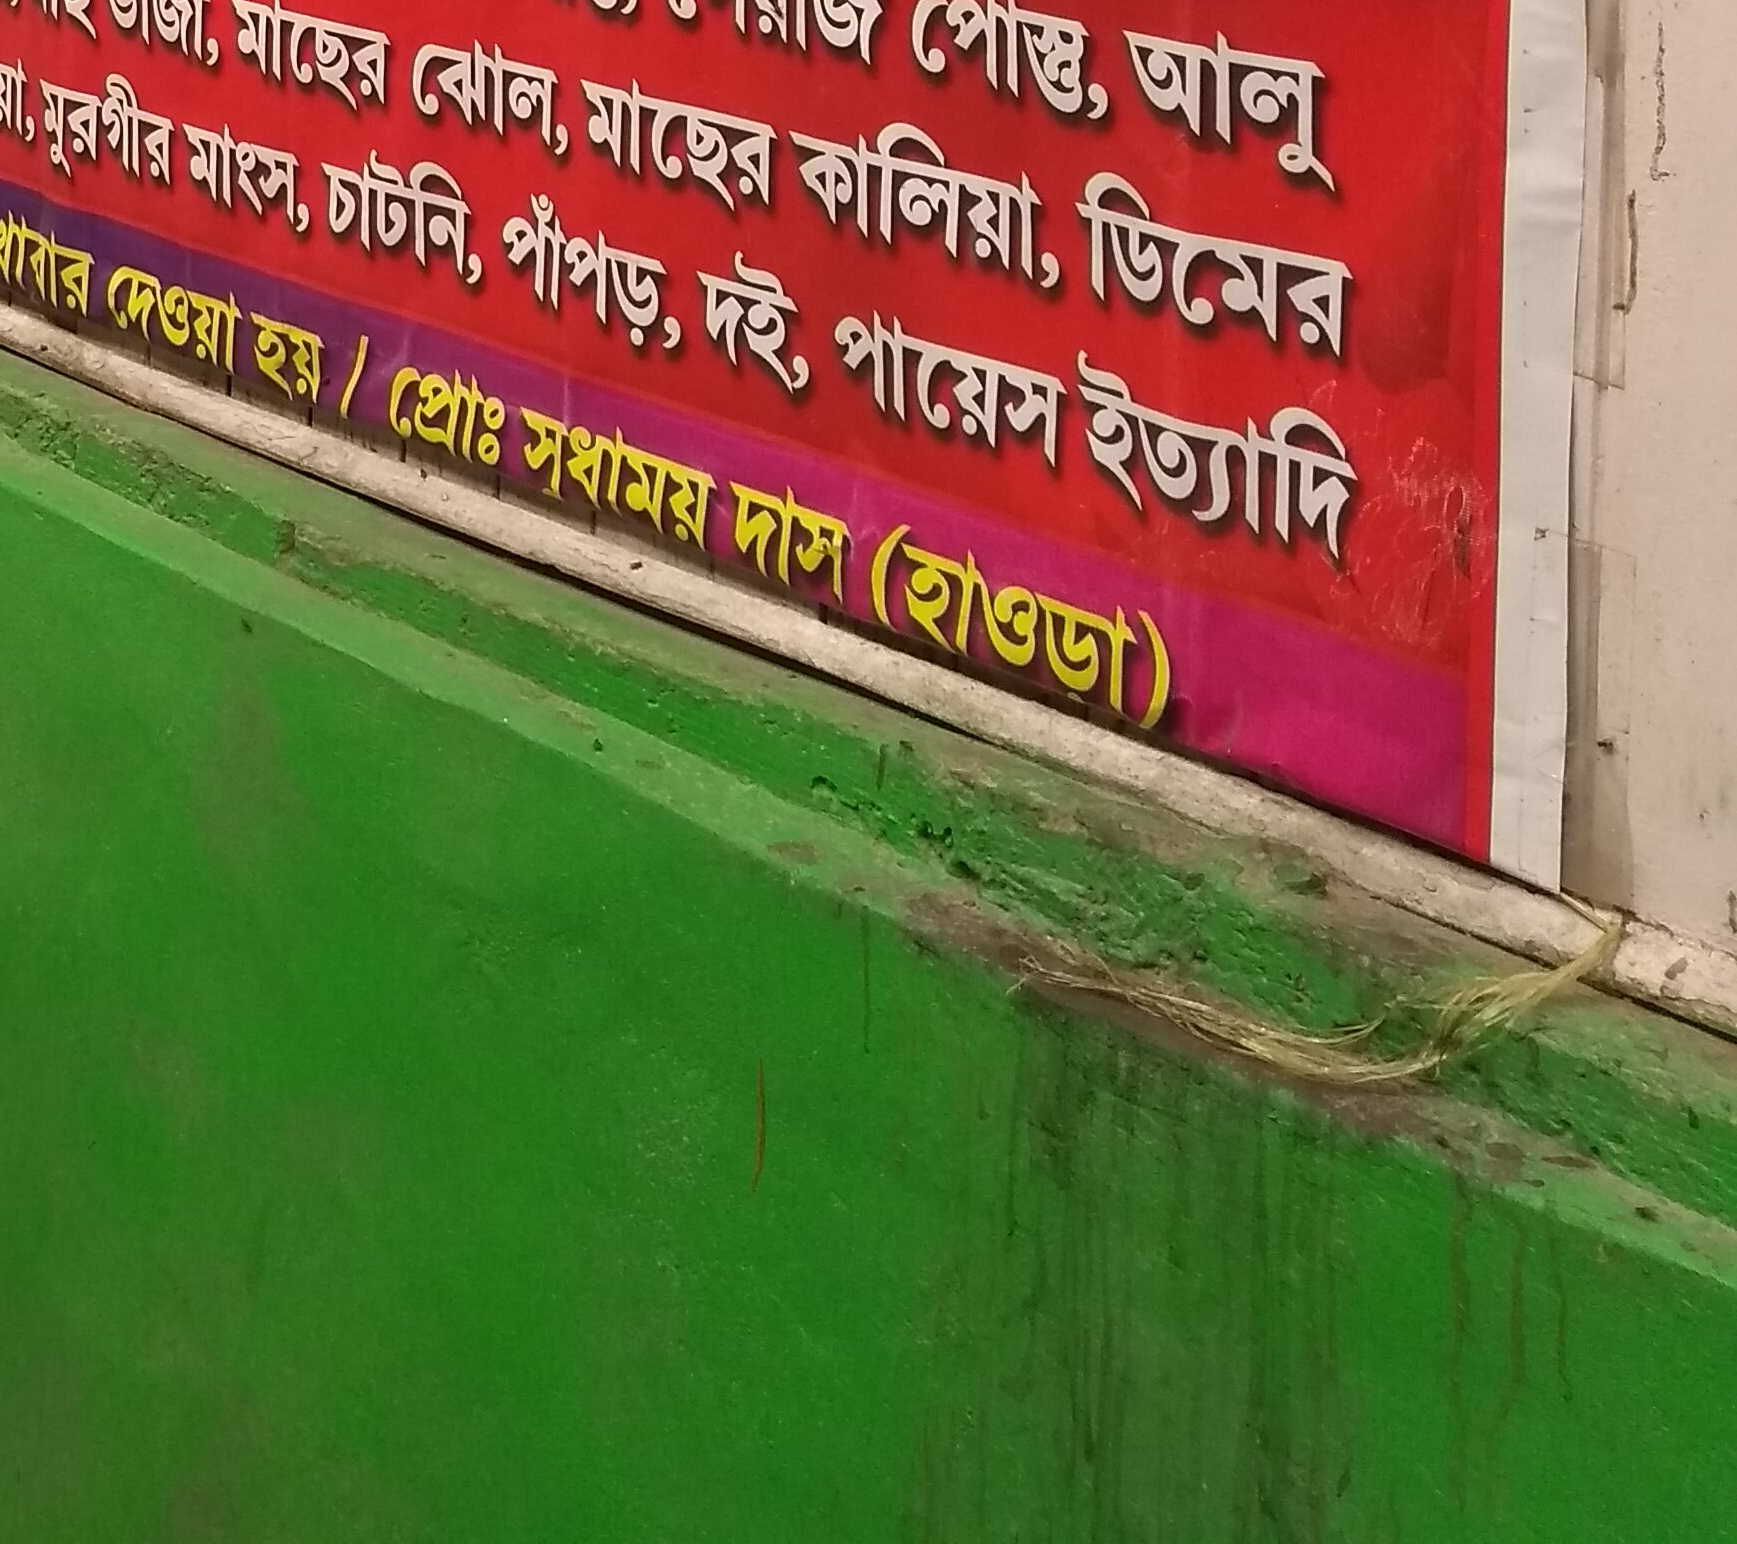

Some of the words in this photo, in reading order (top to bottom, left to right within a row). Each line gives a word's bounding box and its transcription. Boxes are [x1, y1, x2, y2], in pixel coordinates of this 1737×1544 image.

[412, 39, 567, 156] ঝোল,
[580, 78, 777, 210] মাছের
[789, 121, 1060, 287] কালিয়া,
[1077, 171, 1352, 357] ডিমের
[1124, 31, 1335, 192] আলু
[39, 73, 174, 184] মুরগীর
[183, 123, 309, 233] মাংস,
[321, 149, 483, 284] চাটনি,
[502, 194, 681, 351] পাঁপড়,
[695, 251, 810, 393] দই,
[834, 310, 1067, 466] পায়েস
[1076, 350, 1357, 560] ইত্যাদি
[107, 263, 241, 375] দেওয়া
[249, 312, 324, 403] হয়
[729, 481, 853, 604] দাস
